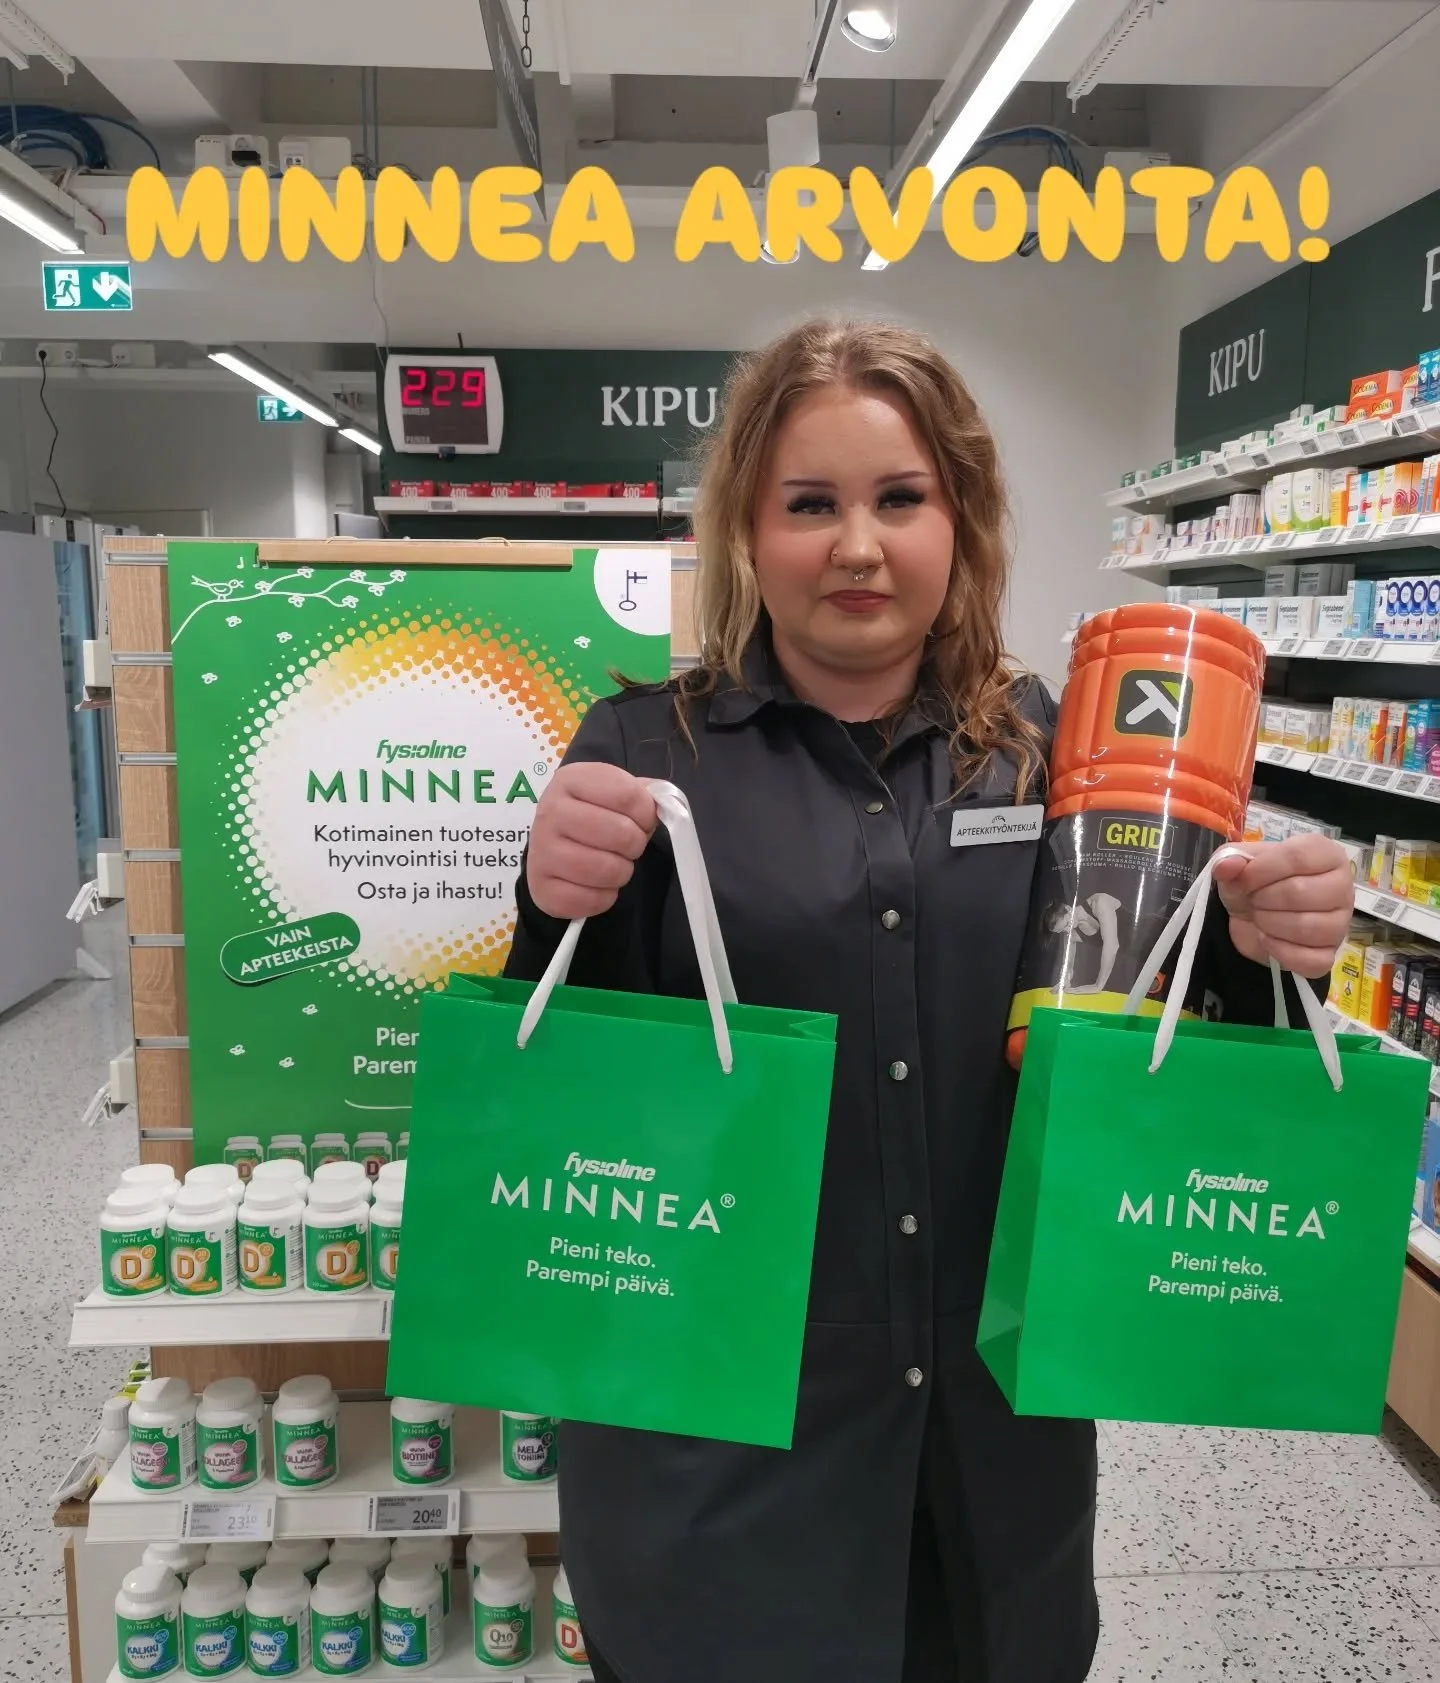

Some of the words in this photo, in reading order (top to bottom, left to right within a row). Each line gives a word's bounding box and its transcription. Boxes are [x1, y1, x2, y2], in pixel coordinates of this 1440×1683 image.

[1208, 328, 1265, 397] KIPU
[402, 369, 486, 408] 229
[601, 386, 718, 428] KIPU
[400, 486, 418, 498] 400
[450, 488, 468, 499] 400
[490, 487, 508, 499] 400
[534, 487, 551, 499] 400
[623, 487, 640, 499] 400
[314, 824, 433, 842] Kotimainen
[957, 821, 1037, 836] APTEEKKITYÖNTEKIJÄ
[1105, 822, 1165, 850] GRID
[328, 848, 457, 872] hyvinvointisi
[357, 881, 407, 899] Osta
[411, 882, 430, 904] ja
[436, 880, 502, 899] ihastu!
[264, 925, 312, 948] VAIN
[240, 935, 354, 976] APTEEKEISTA
[112, 1235, 149, 1245] MINNEA
[243, 1247, 260, 1272] D
[326, 1250, 347, 1276] D
[550, 1236, 600, 1261] Pieni
[605, 1246, 656, 1269] teko.
[1171, 1250, 1218, 1272] Pieni
[1222, 1255, 1267, 1277] teko.
[120, 1255, 142, 1280] D
[176, 1254, 195, 1279] D
[526, 1259, 610, 1292] Parempi
[615, 1274, 675, 1298] päivä.
[1148, 1274, 1225, 1303] Parempi
[1229, 1283, 1284, 1304] päivä.
[195, 1641, 228, 1652] KALKKI
[322, 1641, 353, 1651] KALKKI
[490, 1628, 514, 1645] Q10
[561, 1623, 578, 1649] D
[127, 1644, 159, 1654] KALKKI
